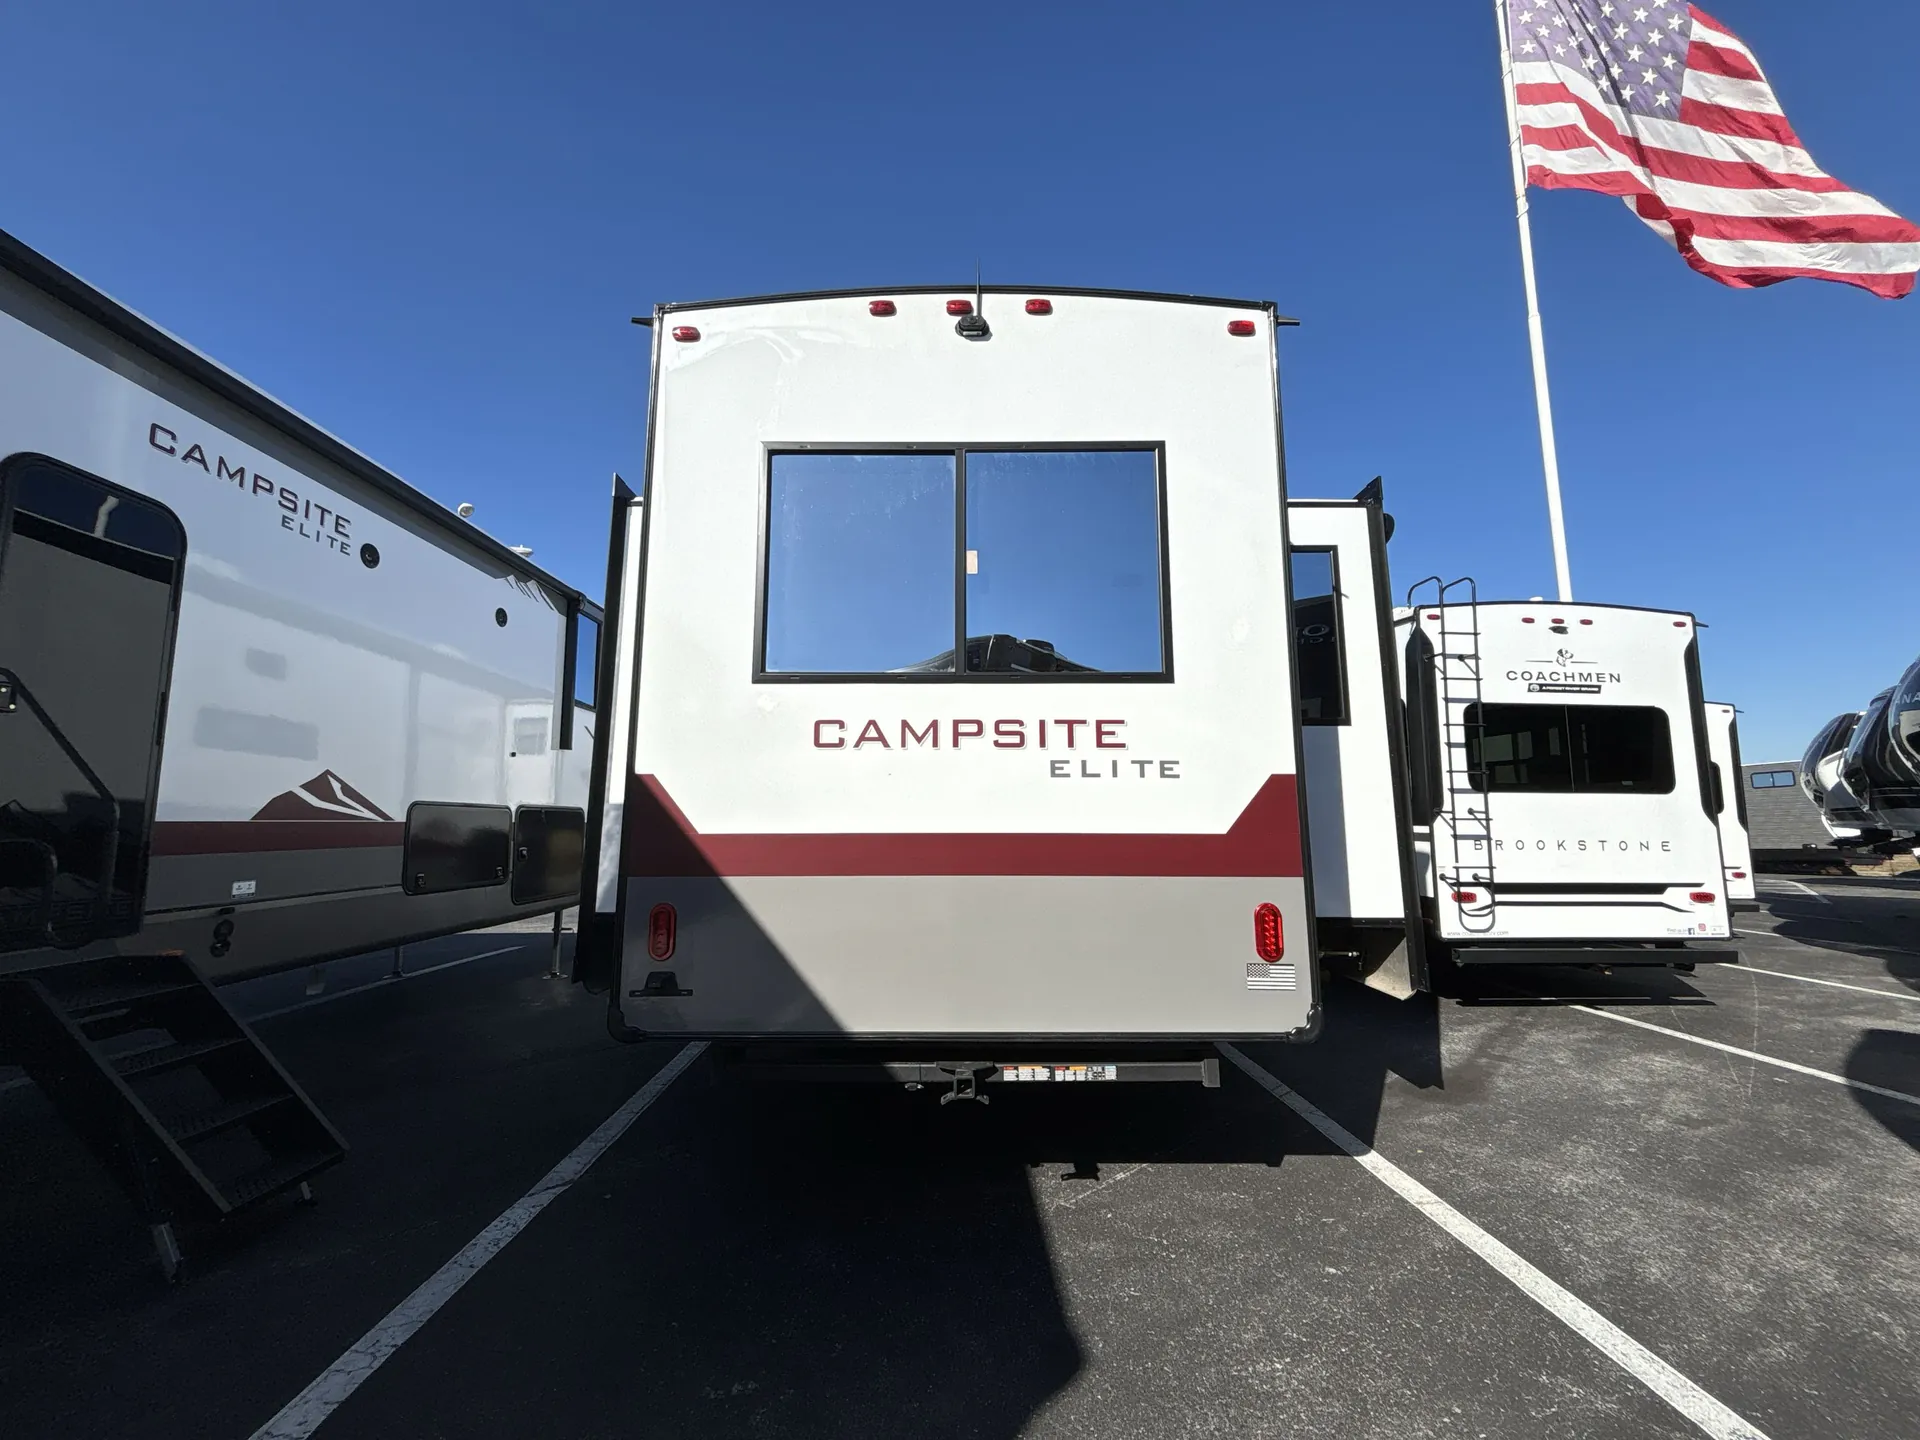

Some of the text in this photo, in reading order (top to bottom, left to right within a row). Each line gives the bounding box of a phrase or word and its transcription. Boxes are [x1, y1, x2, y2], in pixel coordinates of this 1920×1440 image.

[149, 423, 352, 539] CAMPSITE
[281, 514, 351, 556] ELITE
[1506, 670, 1621, 683] COACHMEN
[813, 719, 1128, 750] CAMPSITE
[1050, 760, 1180, 778] ELITE
[1474, 840, 1671, 852] BROOKSTONE
